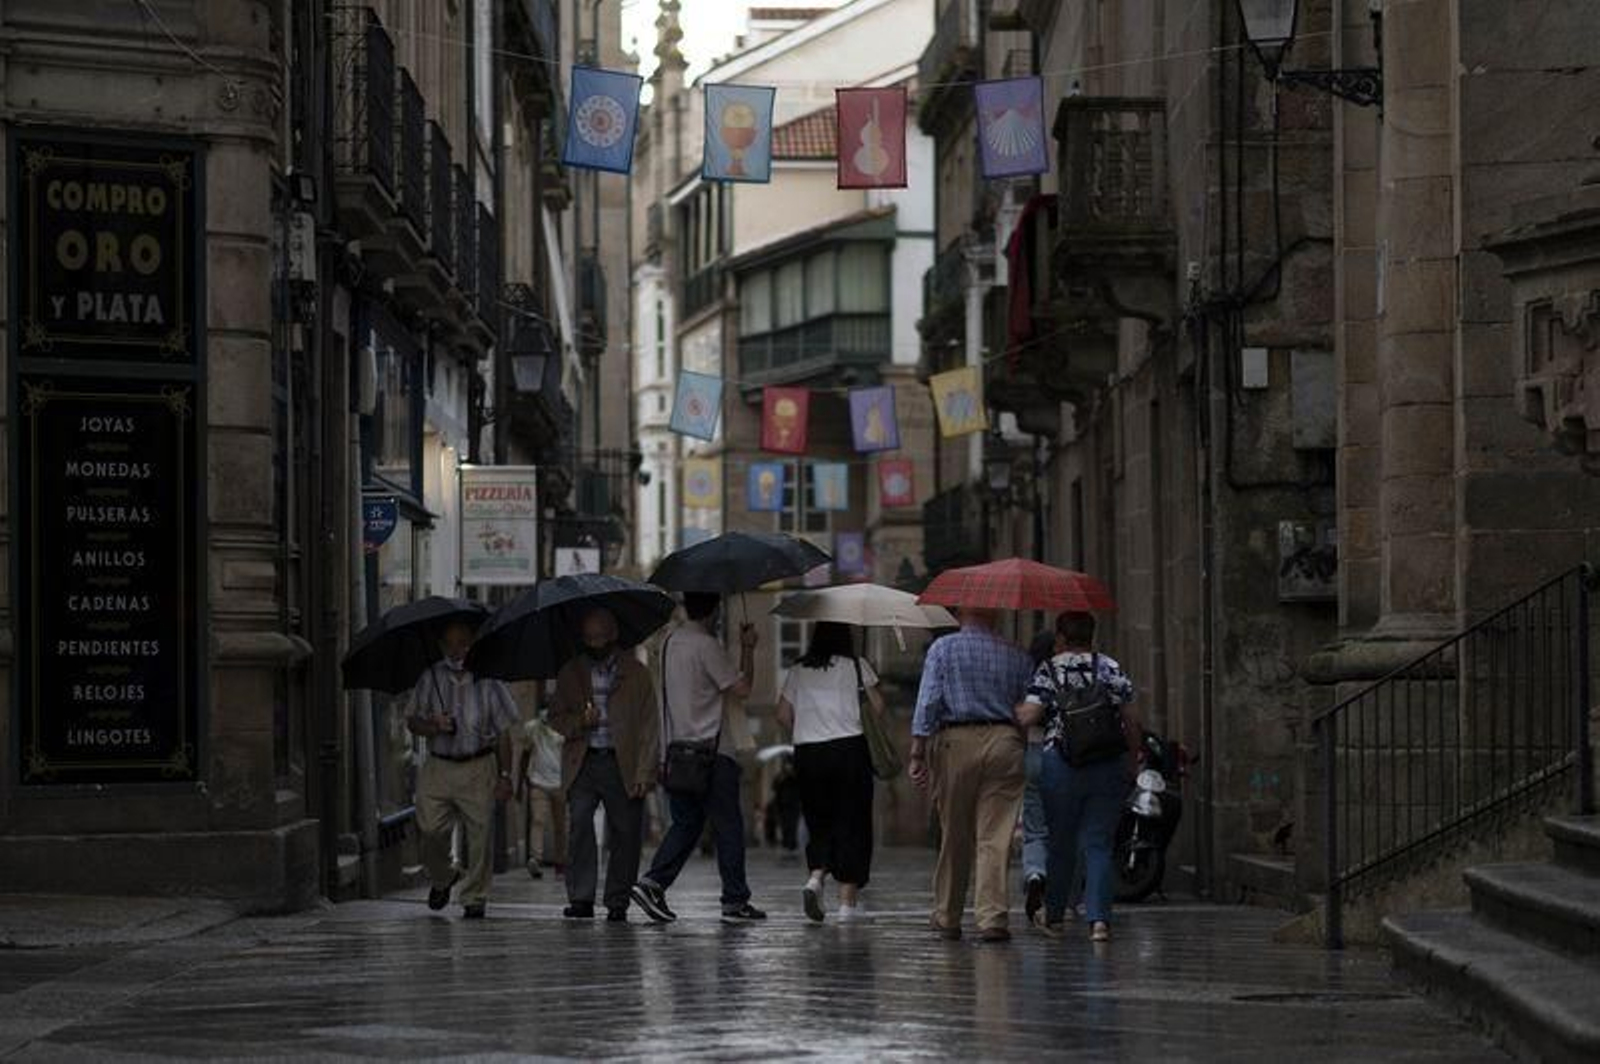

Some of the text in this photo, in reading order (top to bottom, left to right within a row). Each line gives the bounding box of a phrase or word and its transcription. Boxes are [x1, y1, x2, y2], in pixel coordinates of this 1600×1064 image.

[47, 179, 167, 216] COMPRO
[55, 229, 162, 275] ORO
[50, 291, 165, 325] Y PLATA
[79, 416, 135, 433] JOYAS
[65, 461, 151, 478] MONEDAS
[465, 485, 532, 501] PIZZERÍA
[66, 505, 150, 523] PULSERAS
[72, 550, 145, 567] ANILLOS
[68, 594, 150, 611] CADENAS
[58, 640, 160, 656] PENDIENTES
[73, 684, 145, 701] RELOJES
[67, 728, 151, 745] LINGOTES
